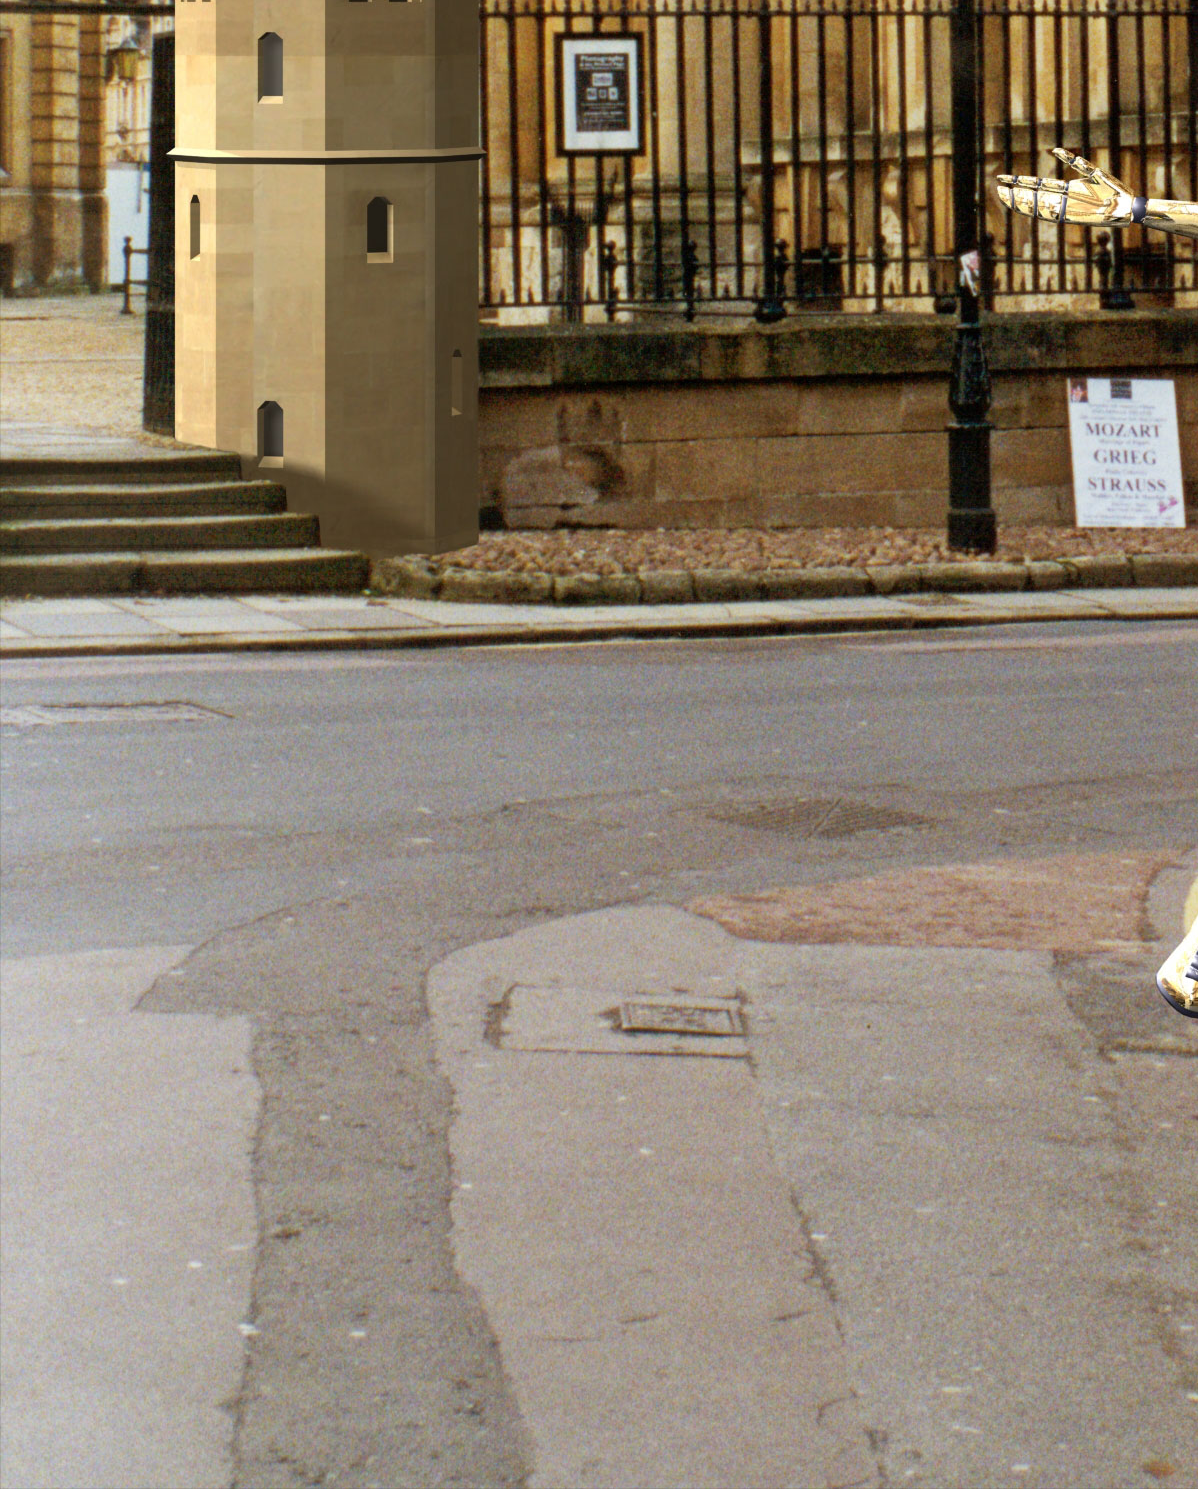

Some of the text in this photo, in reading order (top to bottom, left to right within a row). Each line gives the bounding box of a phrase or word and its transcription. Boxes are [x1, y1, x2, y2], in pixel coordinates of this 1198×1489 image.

[1086, 422, 1161, 438] MOZART
[1093, 448, 1157, 465] GRIEG
[1088, 476, 1166, 491] STRAUSS
